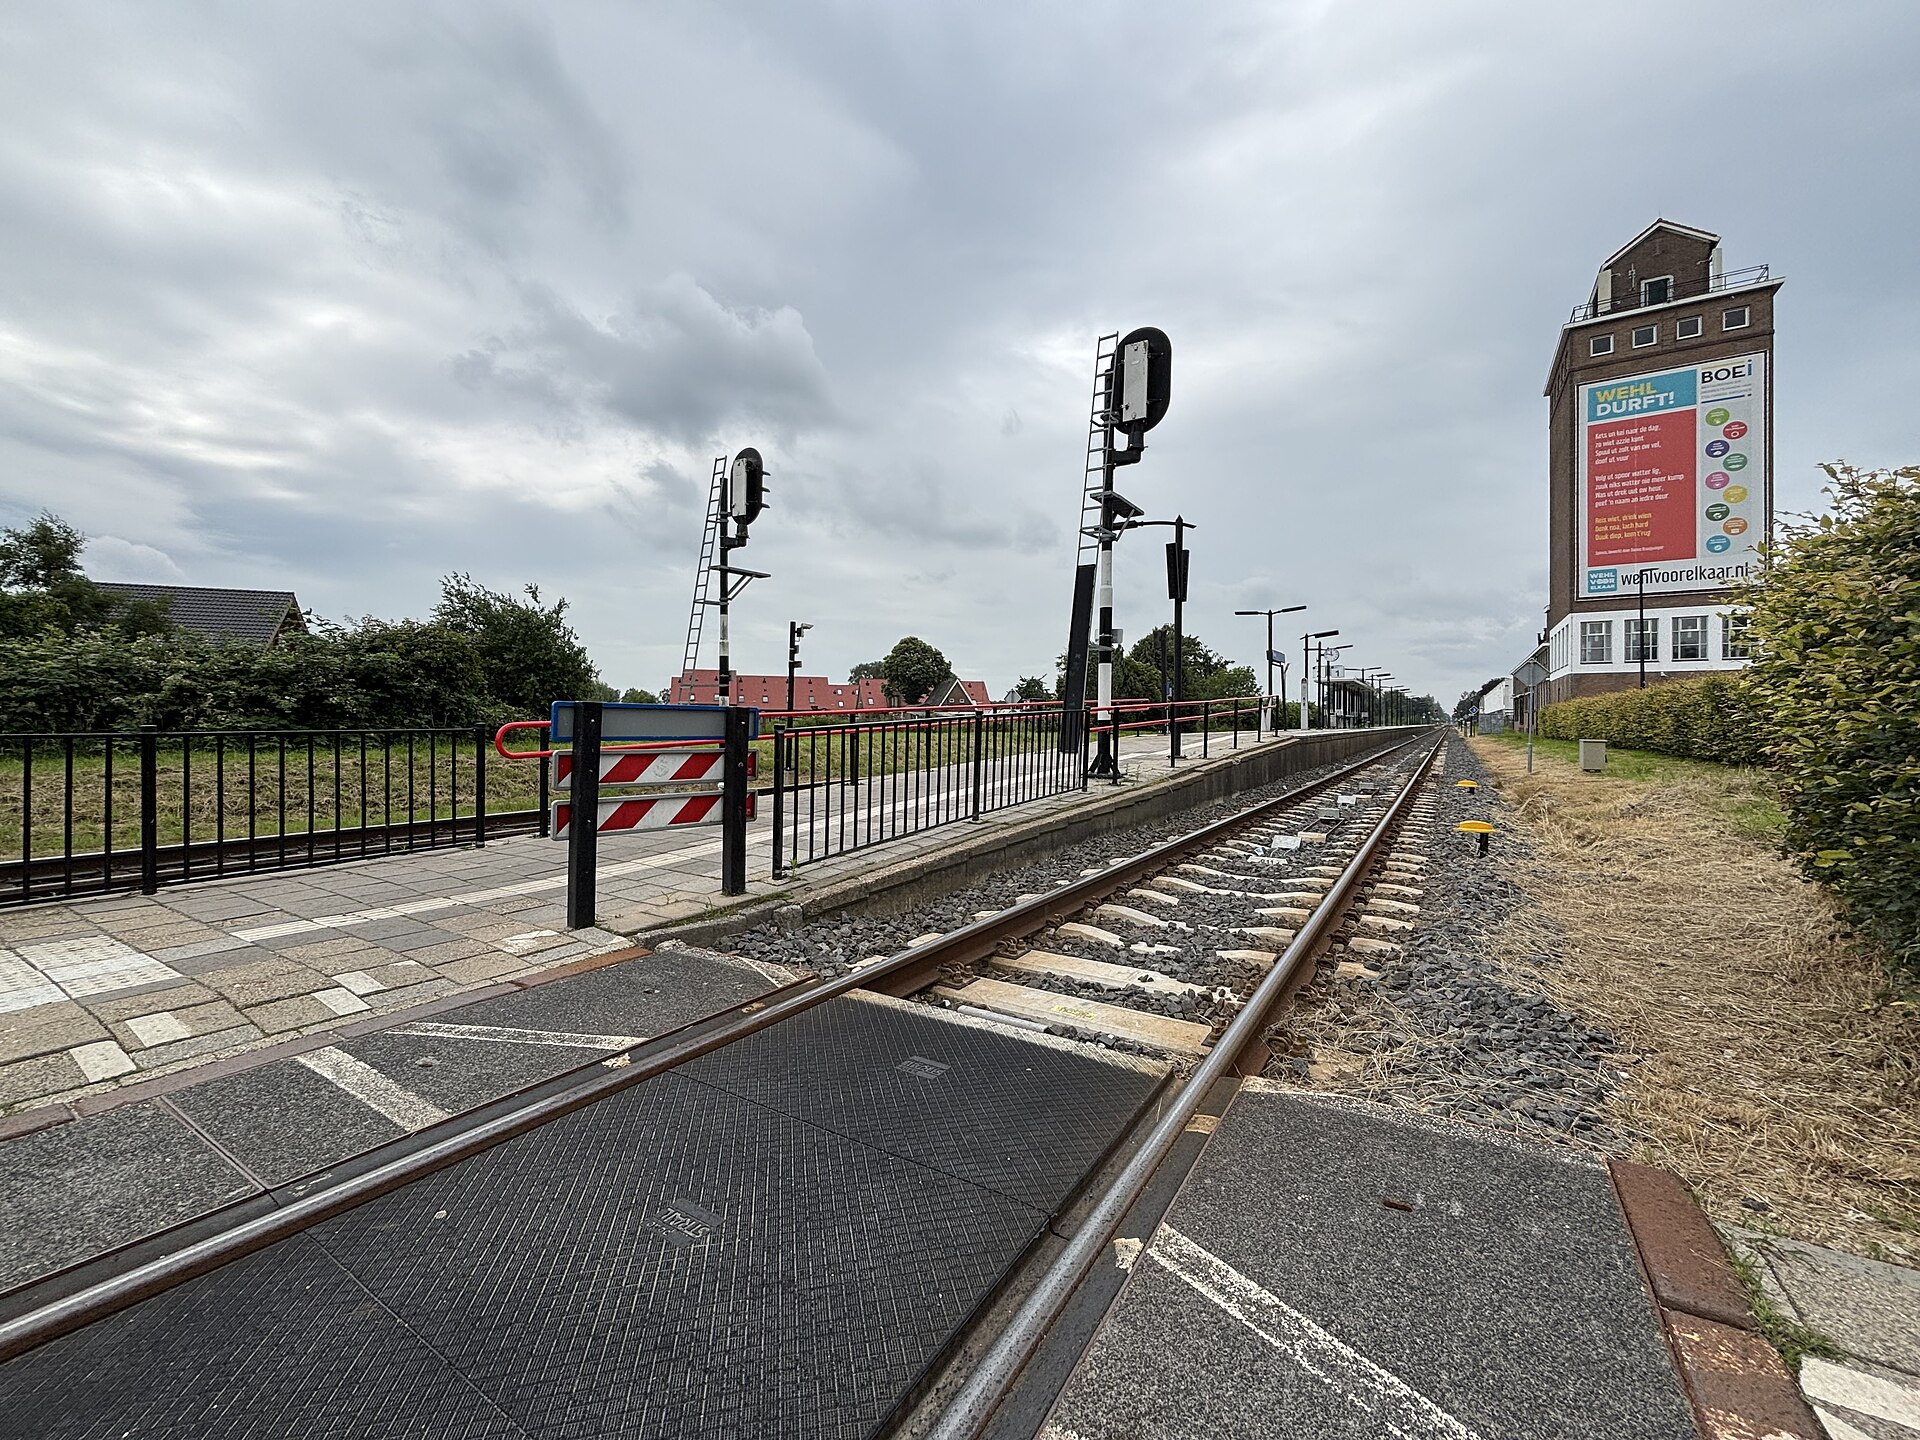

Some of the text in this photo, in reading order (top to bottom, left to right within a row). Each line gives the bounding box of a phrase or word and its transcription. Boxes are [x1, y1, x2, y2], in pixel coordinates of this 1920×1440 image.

[1701, 359, 1753, 384] BOEi
[1595, 381, 1658, 402] WEHL
[1596, 391, 1675, 417] DURFT!
[1590, 577, 1615, 585] VOOR
